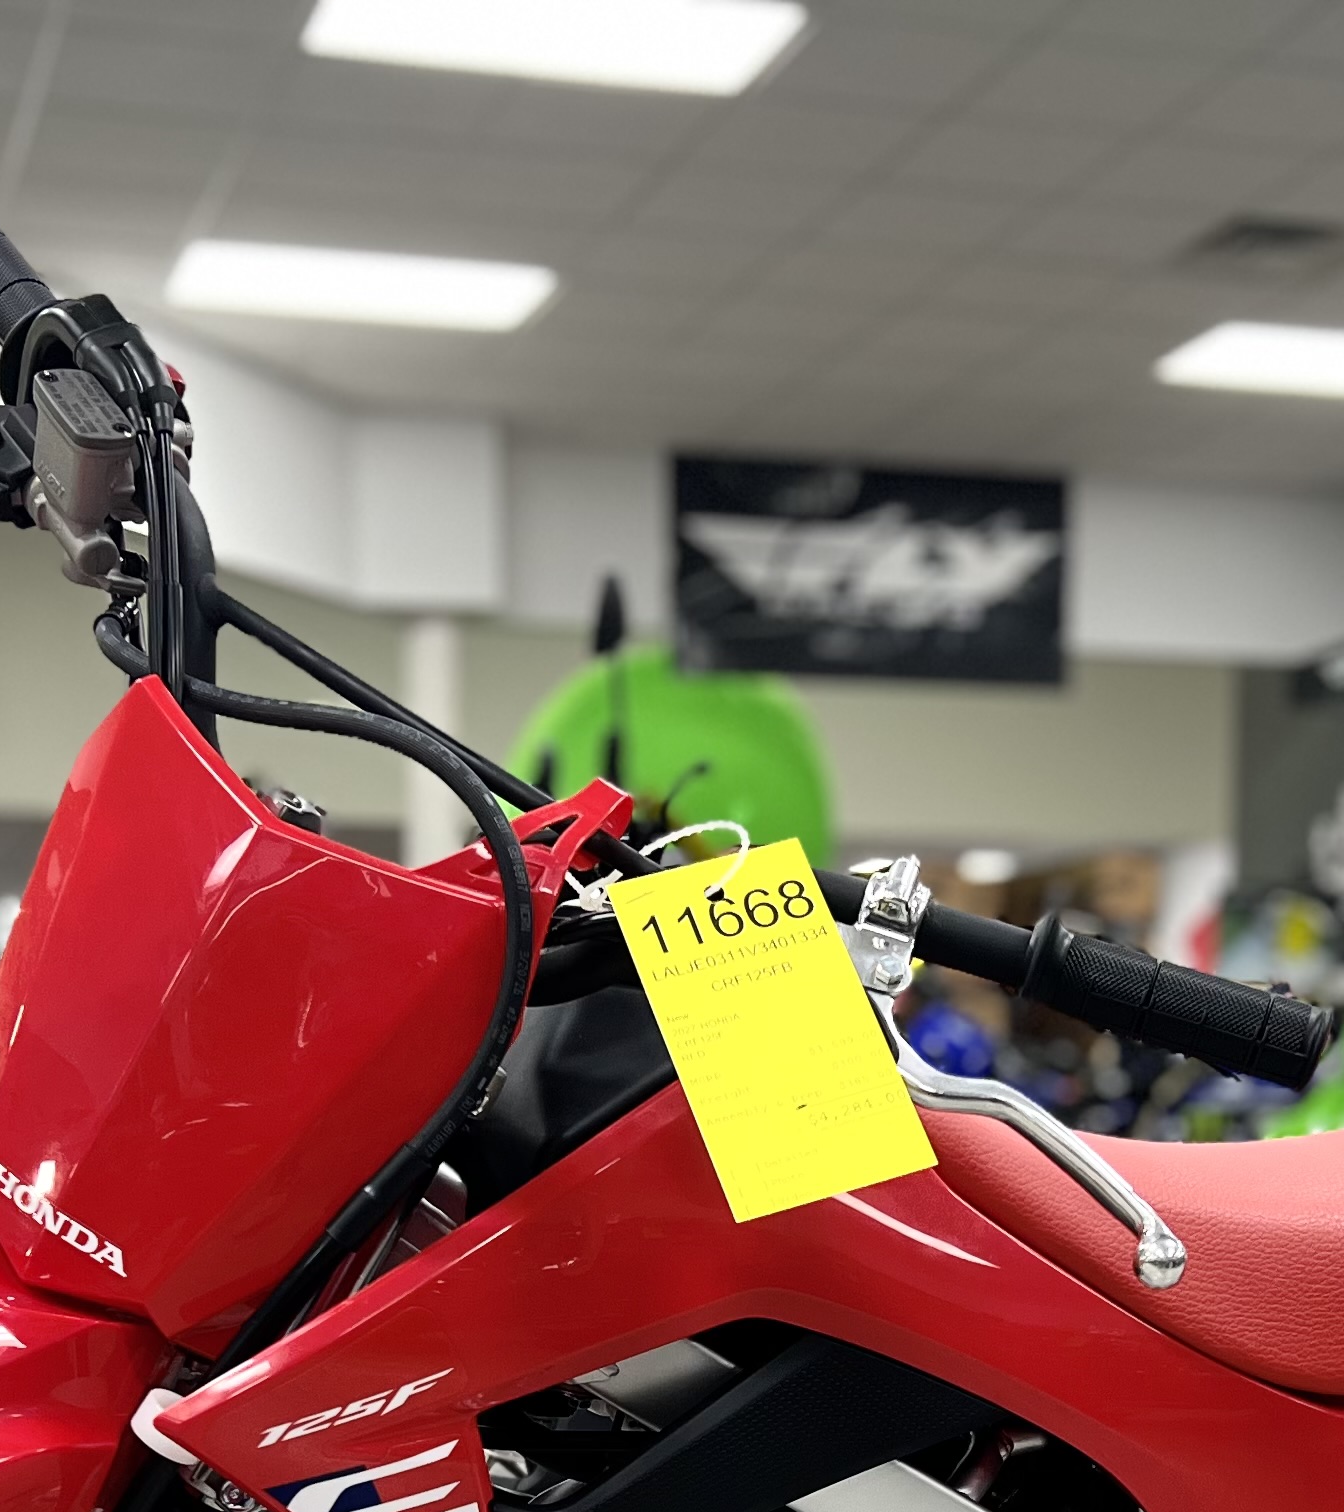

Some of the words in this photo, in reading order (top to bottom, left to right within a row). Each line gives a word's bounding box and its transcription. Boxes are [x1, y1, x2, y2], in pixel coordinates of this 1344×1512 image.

[642, 880, 814, 954] 11668
[711, 961, 793, 992] CRF125FB
[809, 1089, 906, 1126] $4,284.00
[257, 1367, 454, 1449] 125F
